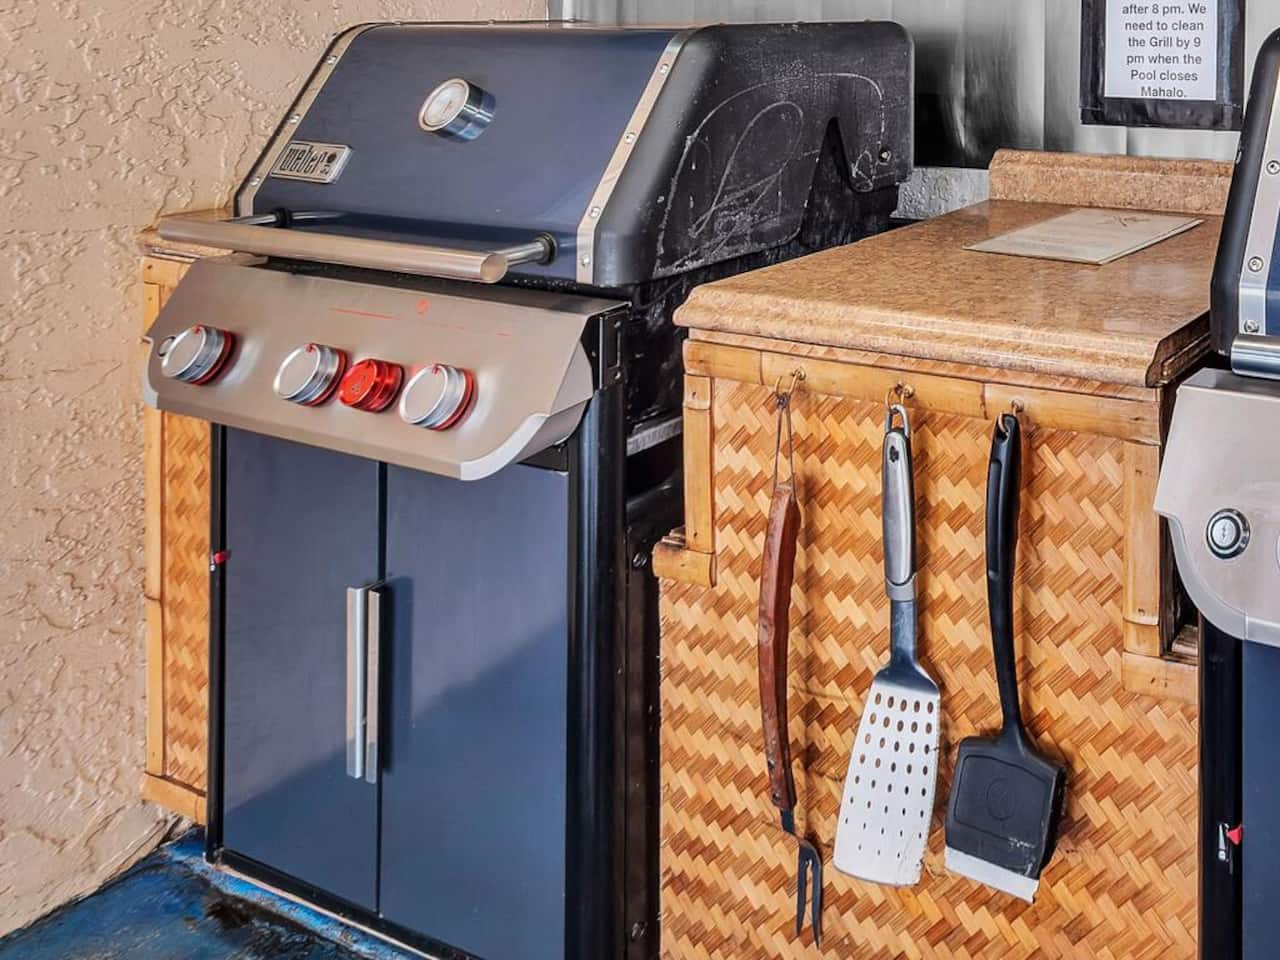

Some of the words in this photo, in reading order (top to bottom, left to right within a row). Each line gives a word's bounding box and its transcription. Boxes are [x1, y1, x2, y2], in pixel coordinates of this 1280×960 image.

[1122, 4, 1149, 14] after
[1152, 5, 1159, 14] 8
[1162, 7, 1184, 16] pm.
[1188, 4, 1206, 13] We
[1125, 21, 1153, 31] need
[1157, 22, 1168, 31] to
[1171, 21, 1204, 31] clean
[1128, 37, 1145, 47] the
[1149, 37, 1172, 47] Grill
[1176, 37, 1189, 49] by
[1194, 38, 1200, 47] 9
[1126, 55, 1144, 66] pm
[1148, 55, 1179, 64] when
[1183, 54, 1202, 64] the
[1131, 70, 1155, 80] Pool
[1160, 70, 1198, 81] closes
[1141, 87, 1187, 97] Mahalo.
